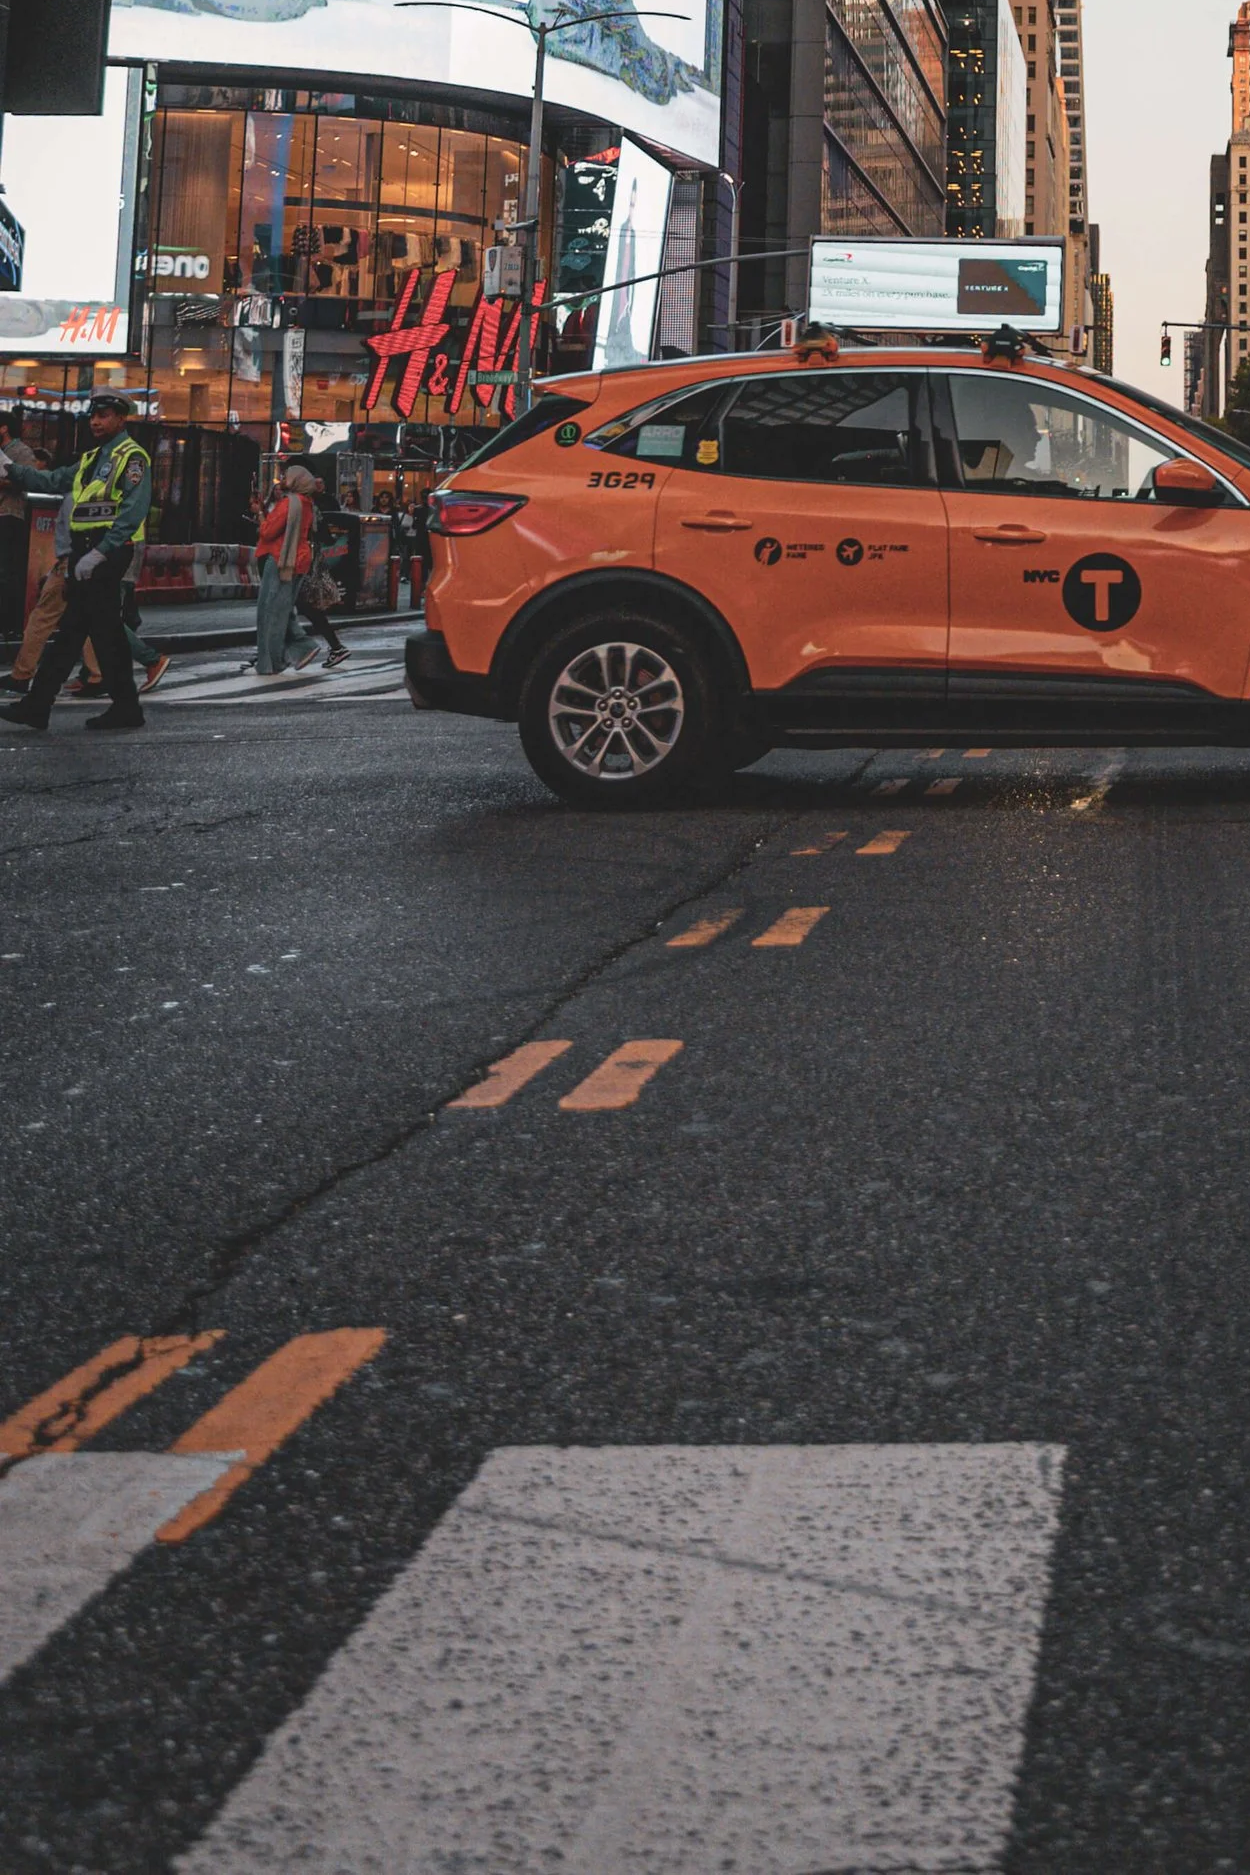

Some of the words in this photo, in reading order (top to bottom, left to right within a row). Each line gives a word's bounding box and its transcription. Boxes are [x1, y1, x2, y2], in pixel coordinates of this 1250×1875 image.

[59, 305, 122, 344] H&M
[365, 268, 549, 422] H&M
[587, 471, 657, 490] 3G29
[1023, 570, 1060, 583] NYC
[1081, 570, 1124, 622] T
